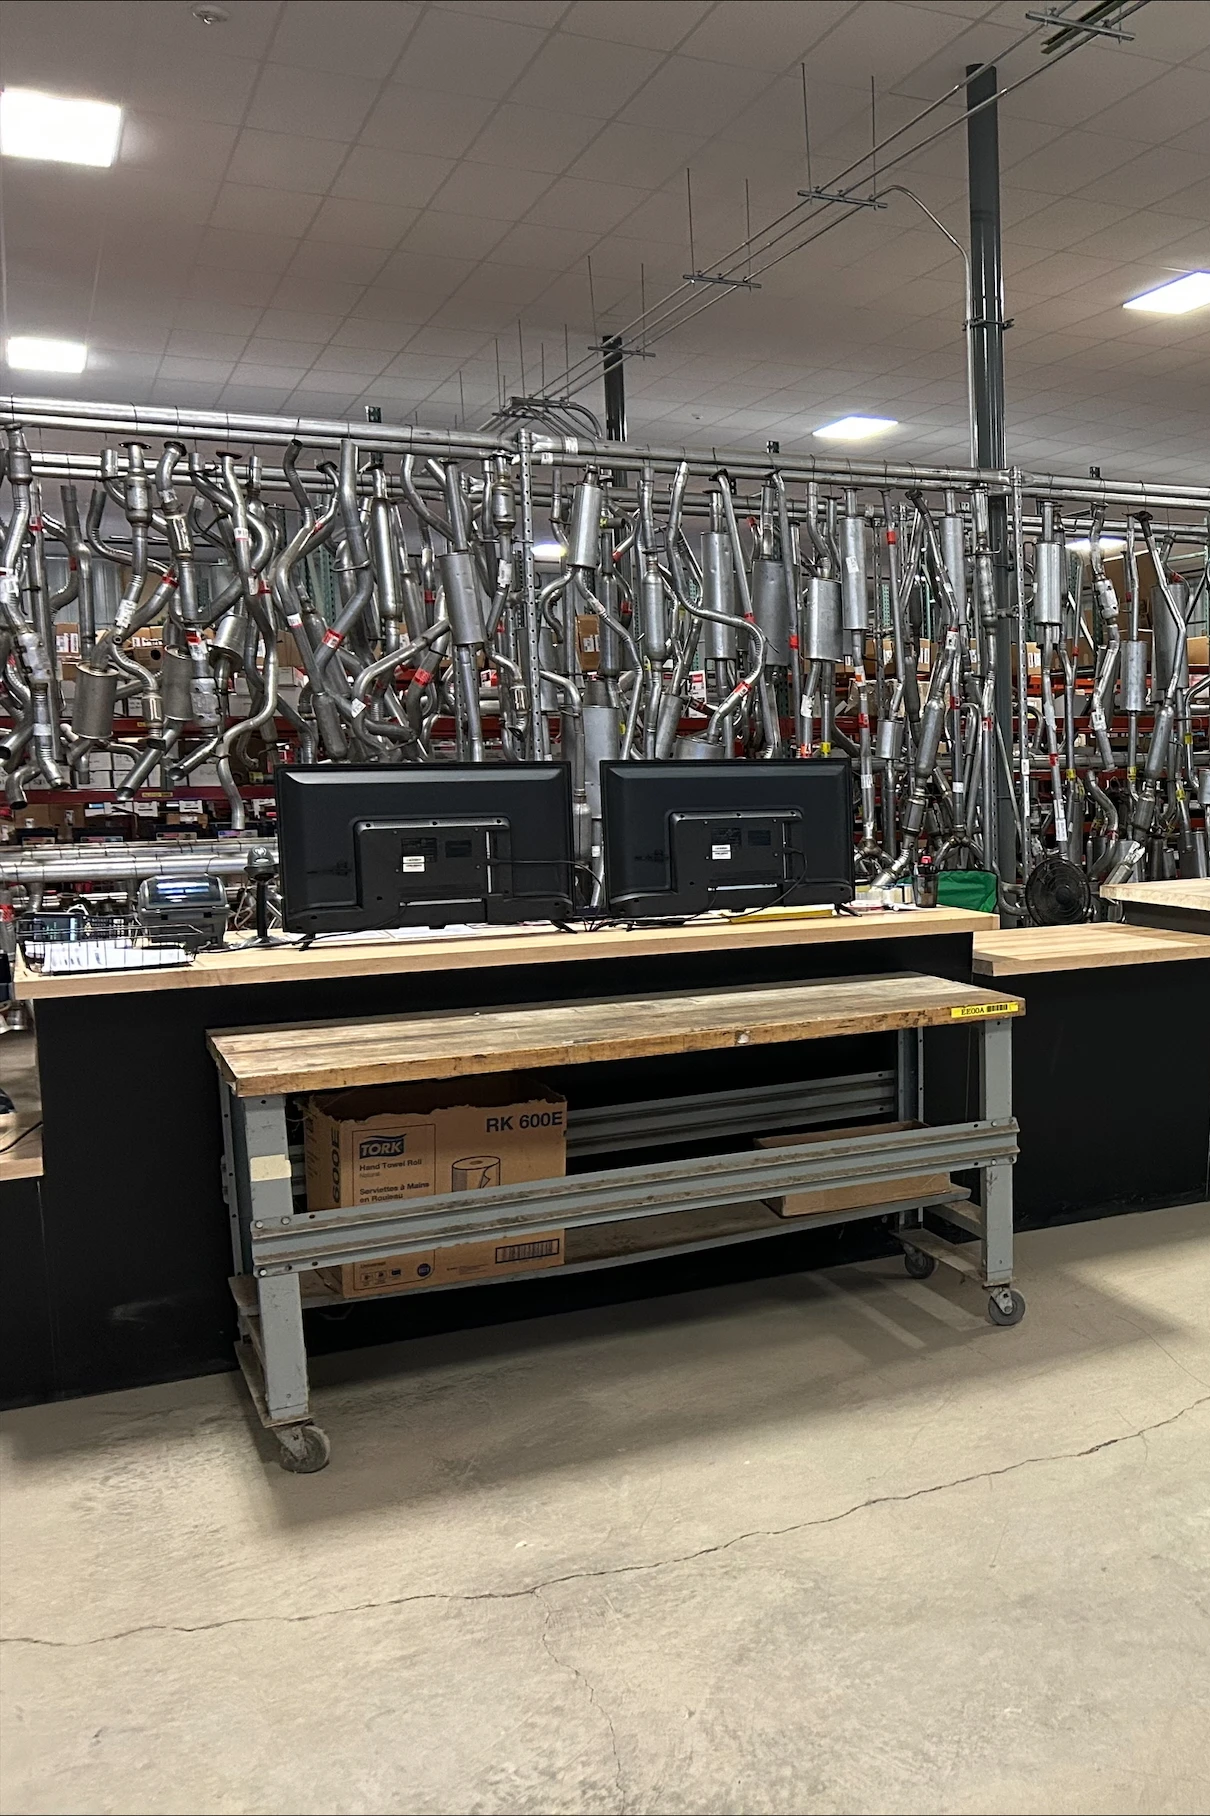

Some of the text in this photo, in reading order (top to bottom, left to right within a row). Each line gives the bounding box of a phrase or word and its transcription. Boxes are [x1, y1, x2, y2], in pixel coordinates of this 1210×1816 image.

[486, 1111, 563, 1132] RK 600E
[360, 1141, 402, 1156] TORK
[331, 1126, 340, 1203] 600E
[359, 1163, 380, 1171] Hand
[382, 1160, 405, 1169] Towel
[359, 1187, 399, 1195] Serviettes
[406, 1182, 430, 1190] Mains
[371, 1193, 403, 1202] Rouleau
